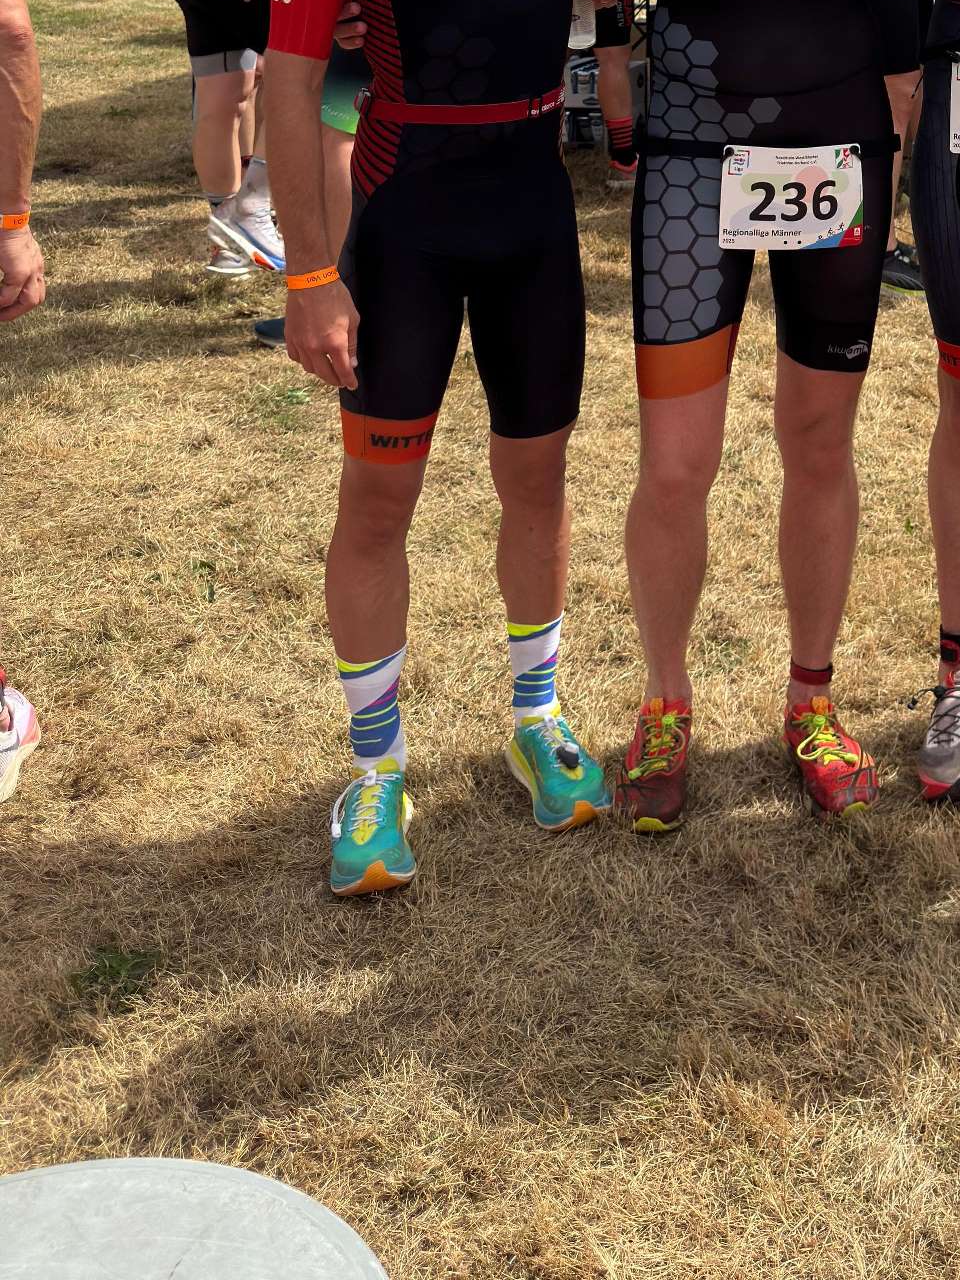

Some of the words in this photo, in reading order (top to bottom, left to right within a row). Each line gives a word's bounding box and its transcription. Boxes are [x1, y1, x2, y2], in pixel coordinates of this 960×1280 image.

[749, 180, 838, 222] 236
[722, 228, 769, 237] Regionalliga
[771, 229, 802, 237] Männer
